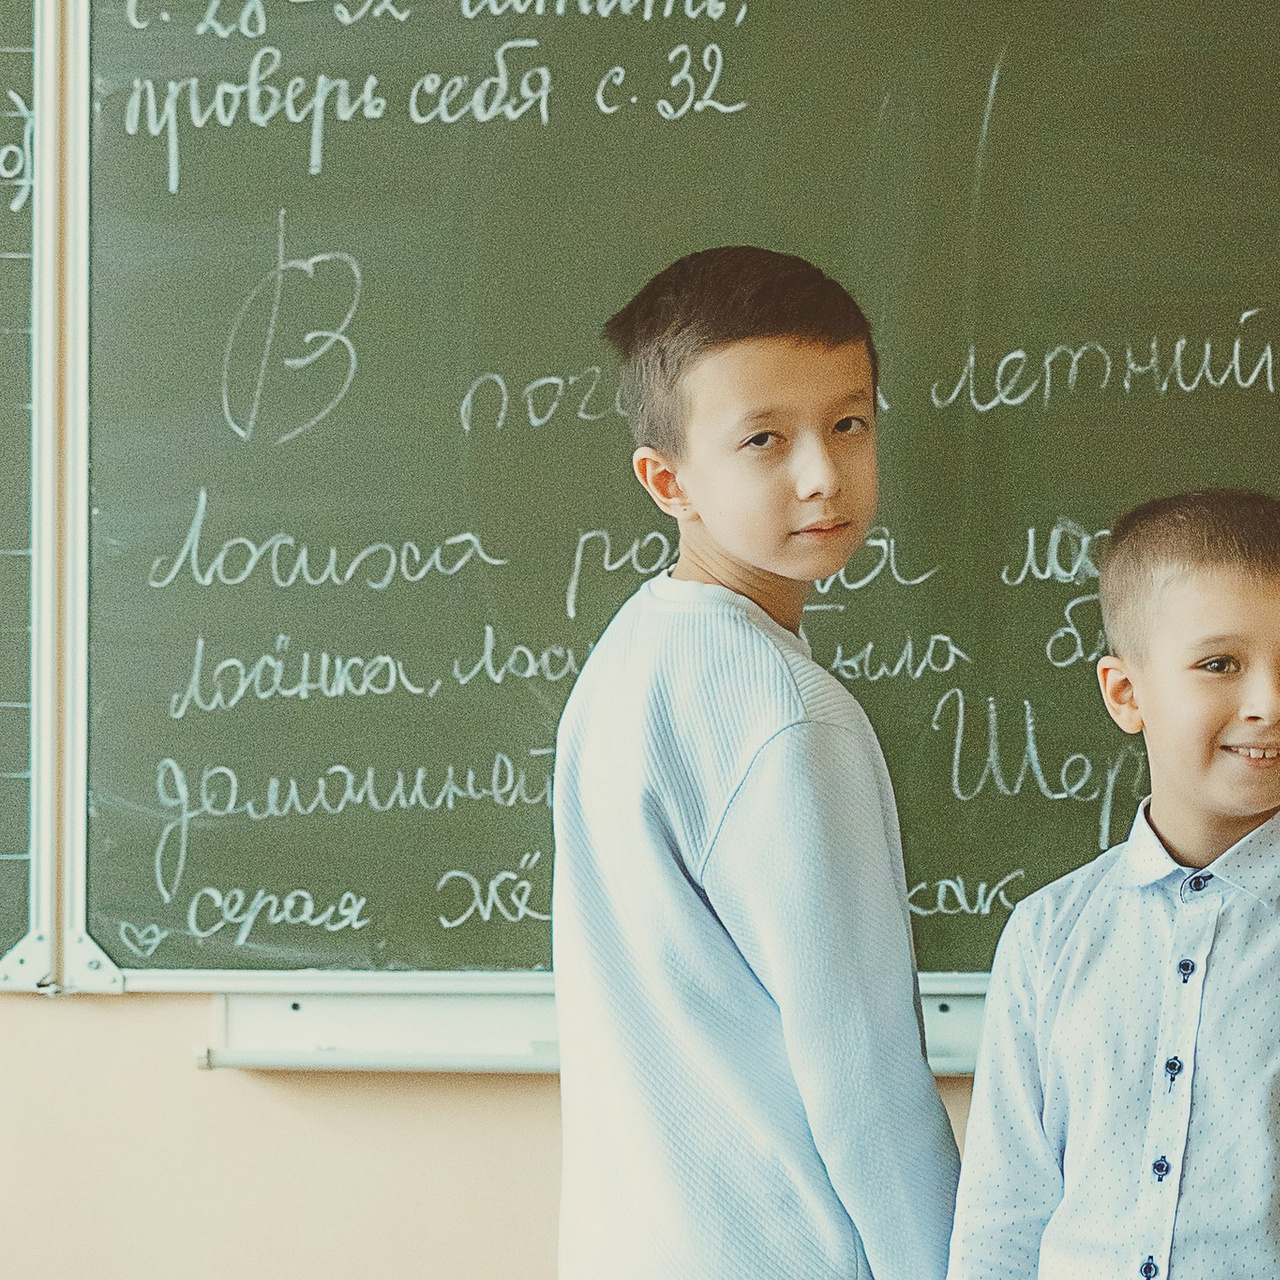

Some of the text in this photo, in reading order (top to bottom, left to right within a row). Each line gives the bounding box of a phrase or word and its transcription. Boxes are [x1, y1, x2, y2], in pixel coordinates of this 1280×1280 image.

[126, 46, 388, 194] проверь
[408, 39, 551, 126] себя
[656, 43, 747, 120] 32
[932, 308, 1276, 412] летний
[188, 884, 369, 946] серая
